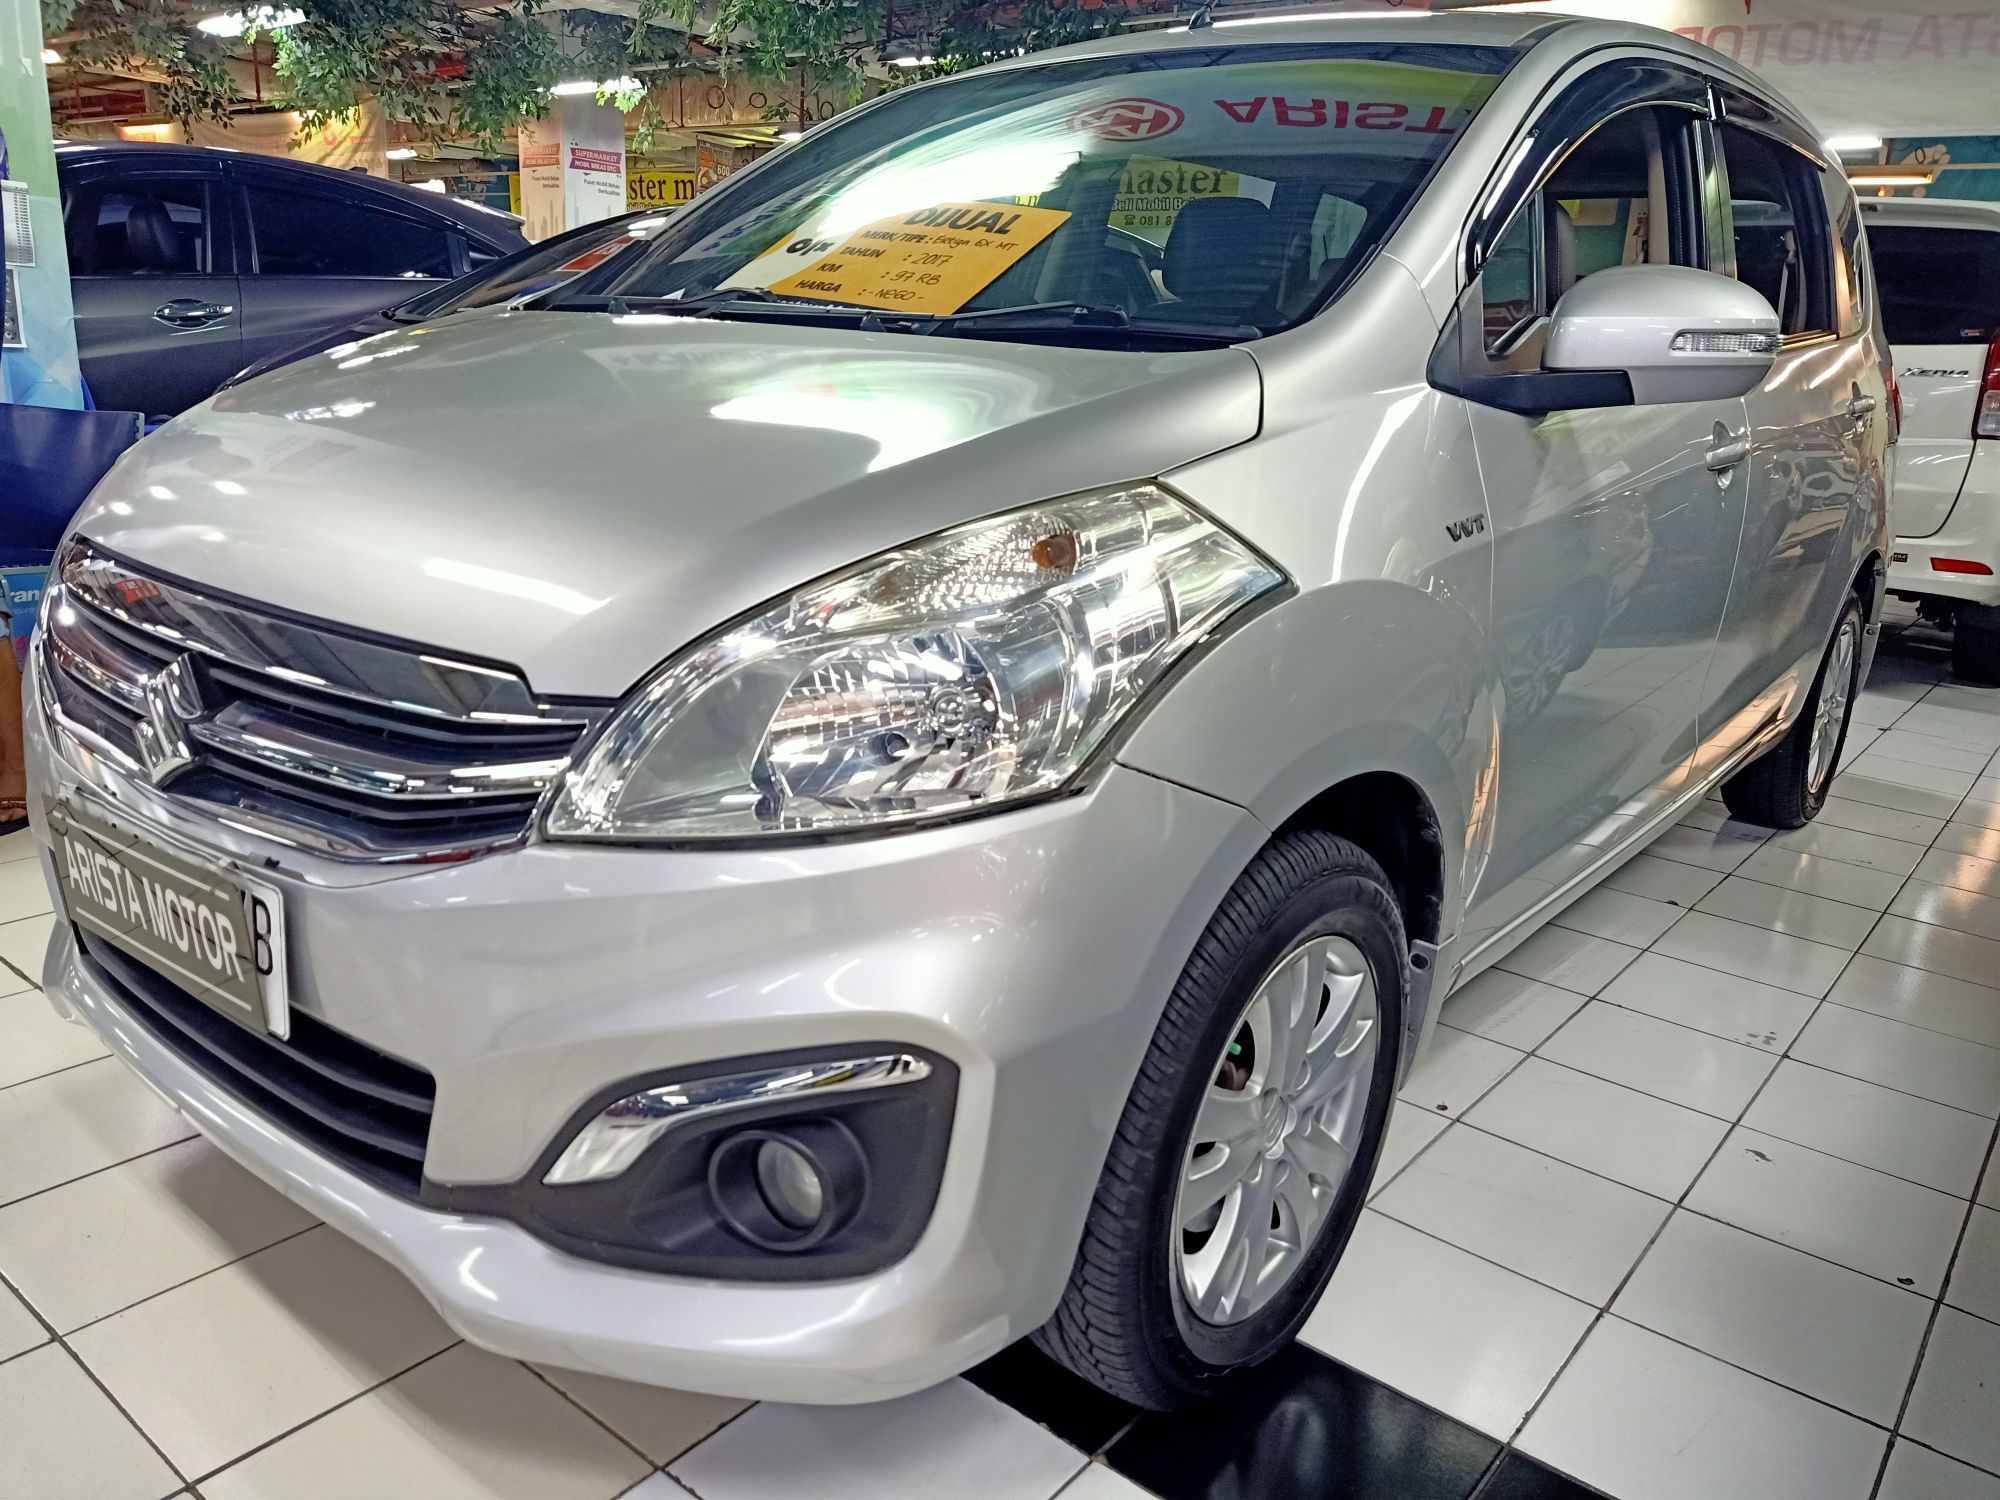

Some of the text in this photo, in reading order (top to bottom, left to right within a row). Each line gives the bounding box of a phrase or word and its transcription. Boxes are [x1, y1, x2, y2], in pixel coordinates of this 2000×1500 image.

[575, 149, 617, 163] SUPERMARKET
[574, 160, 590, 168] MOBIL
[591, 162, 606, 170] BEKAS
[717, 164, 730, 176] 600
[627, 174, 667, 201] ster
[1135, 197, 1170, 211] Mobil
[903, 207, 1022, 235] DIJUAL
[1139, 215, 1159, 226] 081
[996, 241, 1019, 251] MT
[840, 246, 886, 258] TAHUN
[911, 252, 953, 267] 2017
[816, 262, 843, 272] KM
[890, 270, 915, 283] 97
[915, 273, 942, 286] RB
[794, 279, 842, 293] HARGA
[1445, 513, 1484, 542] VVT
[63, 835, 245, 983] ARISTA MOTOR
